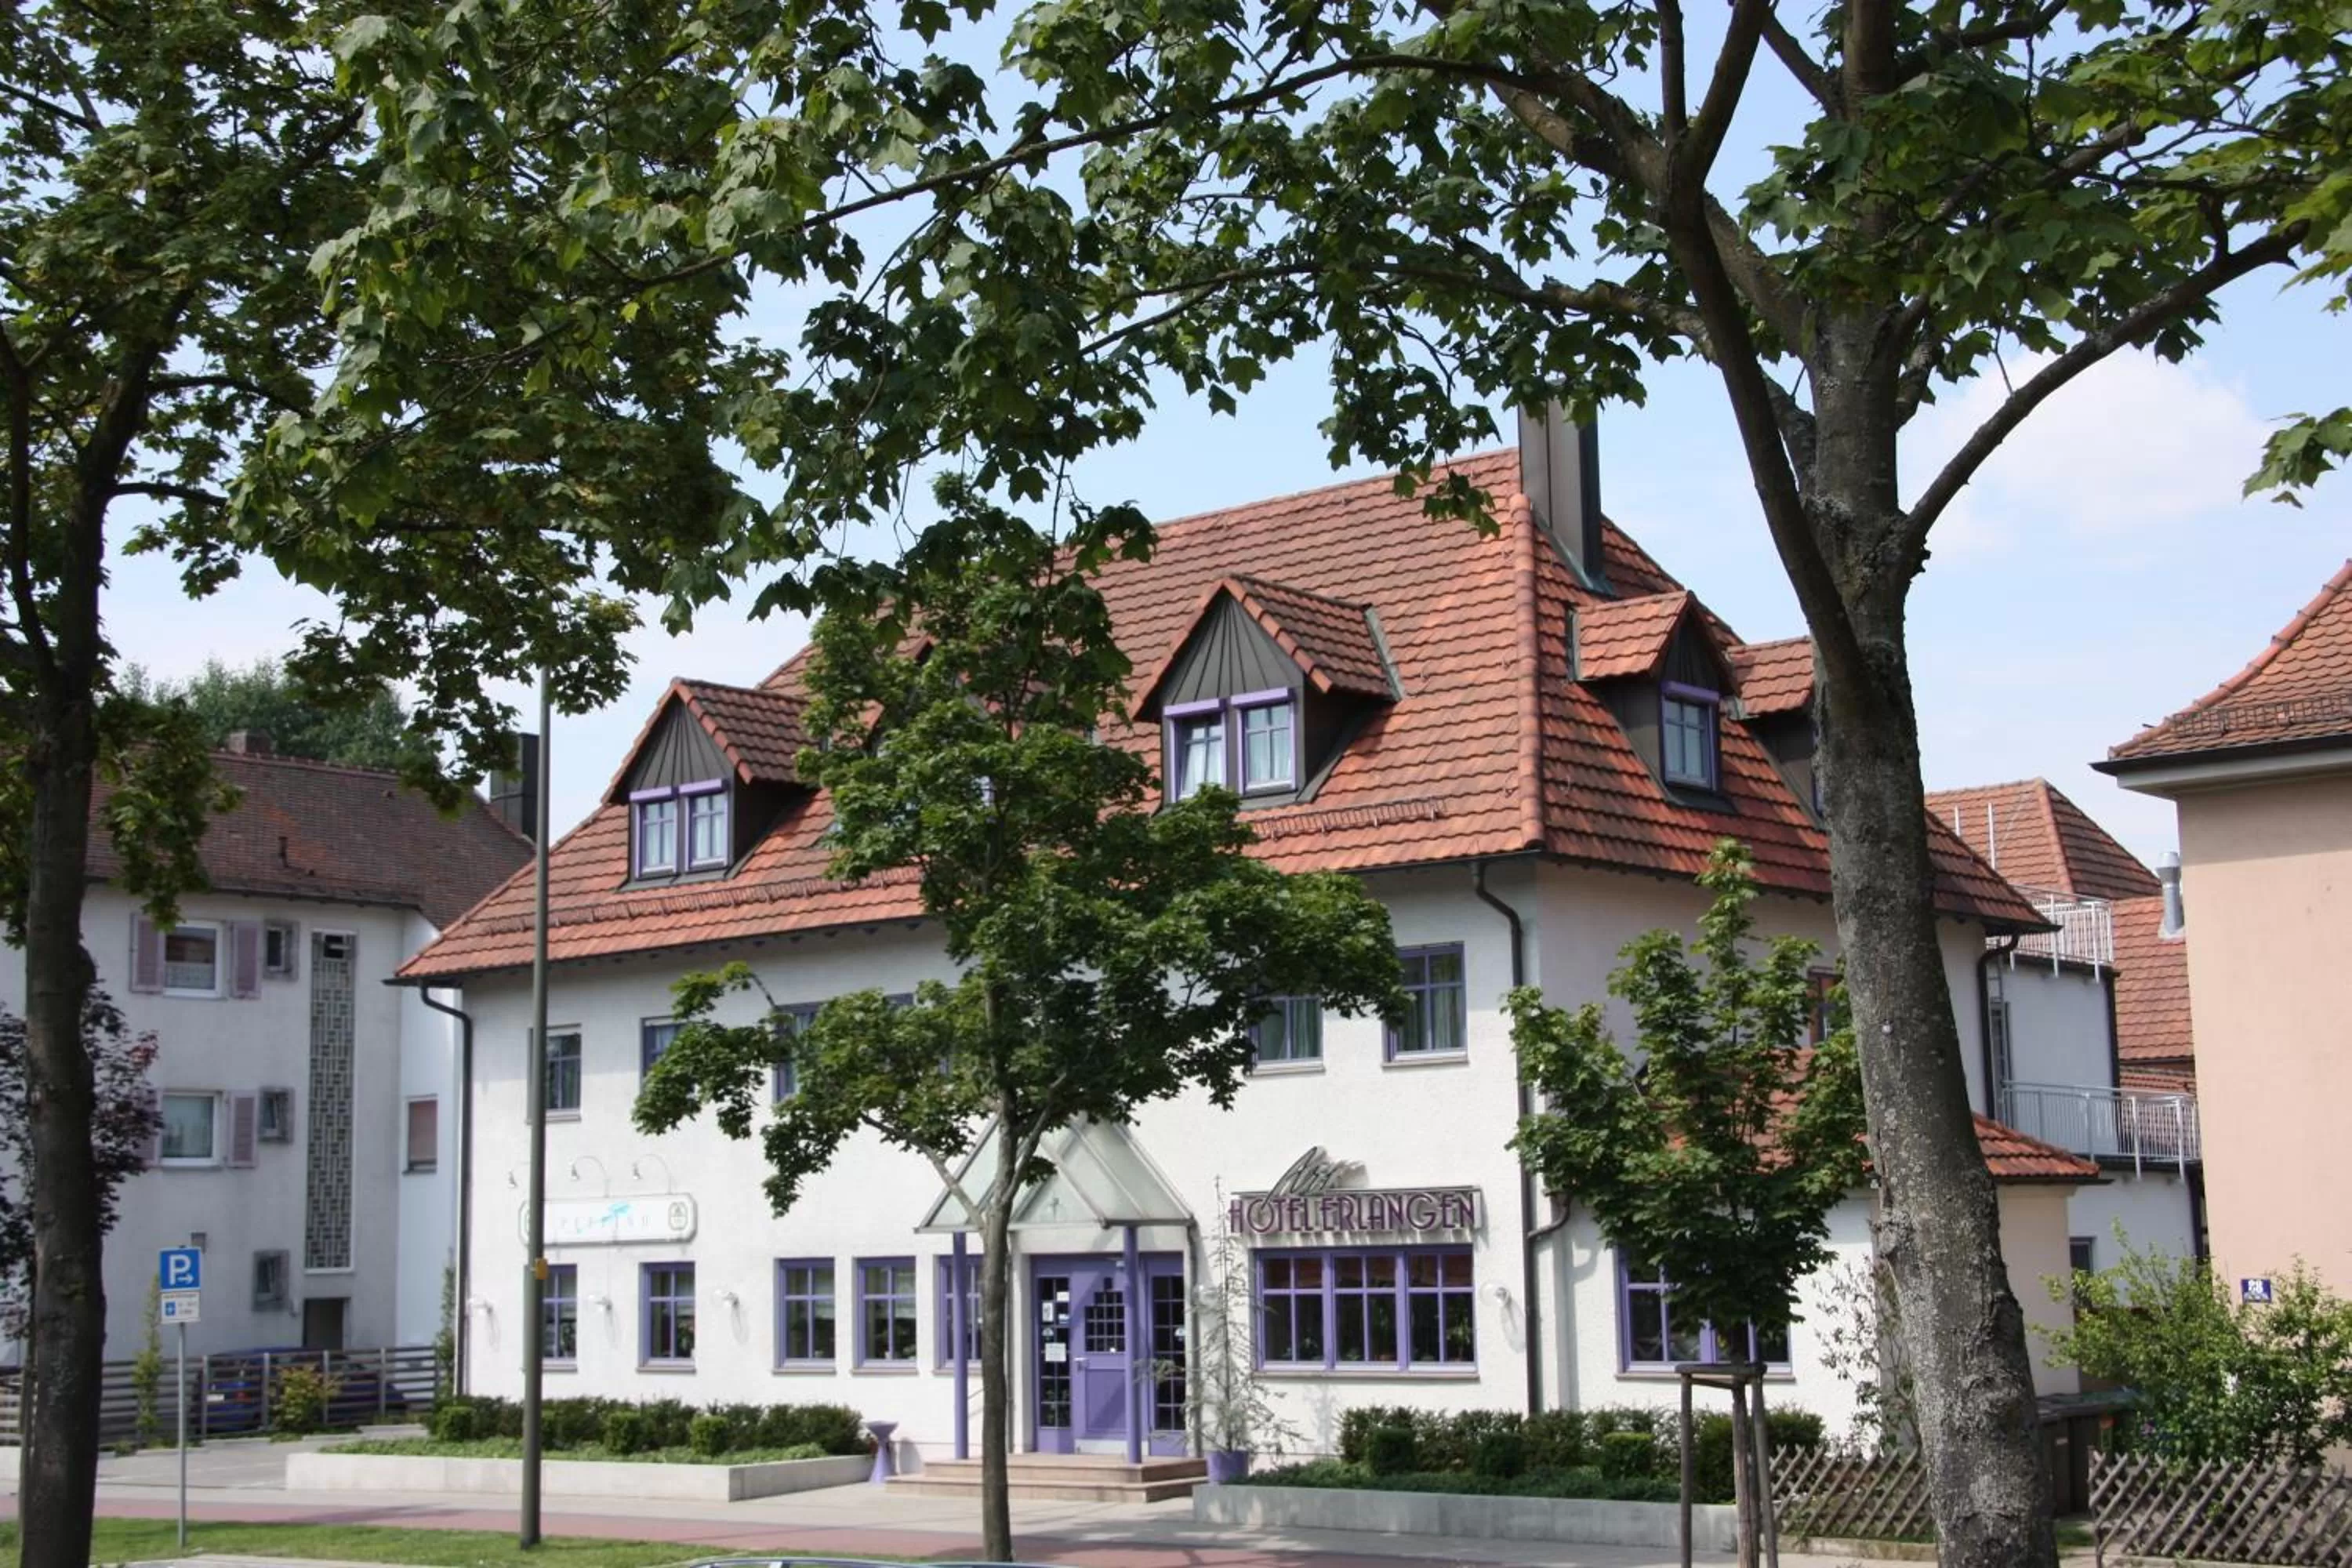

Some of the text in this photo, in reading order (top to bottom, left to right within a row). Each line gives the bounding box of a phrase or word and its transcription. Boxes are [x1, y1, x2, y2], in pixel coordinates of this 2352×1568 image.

[1229, 1191, 1475, 1233] HOTEL ERLANGEN
[169, 1254, 192, 1286] P
